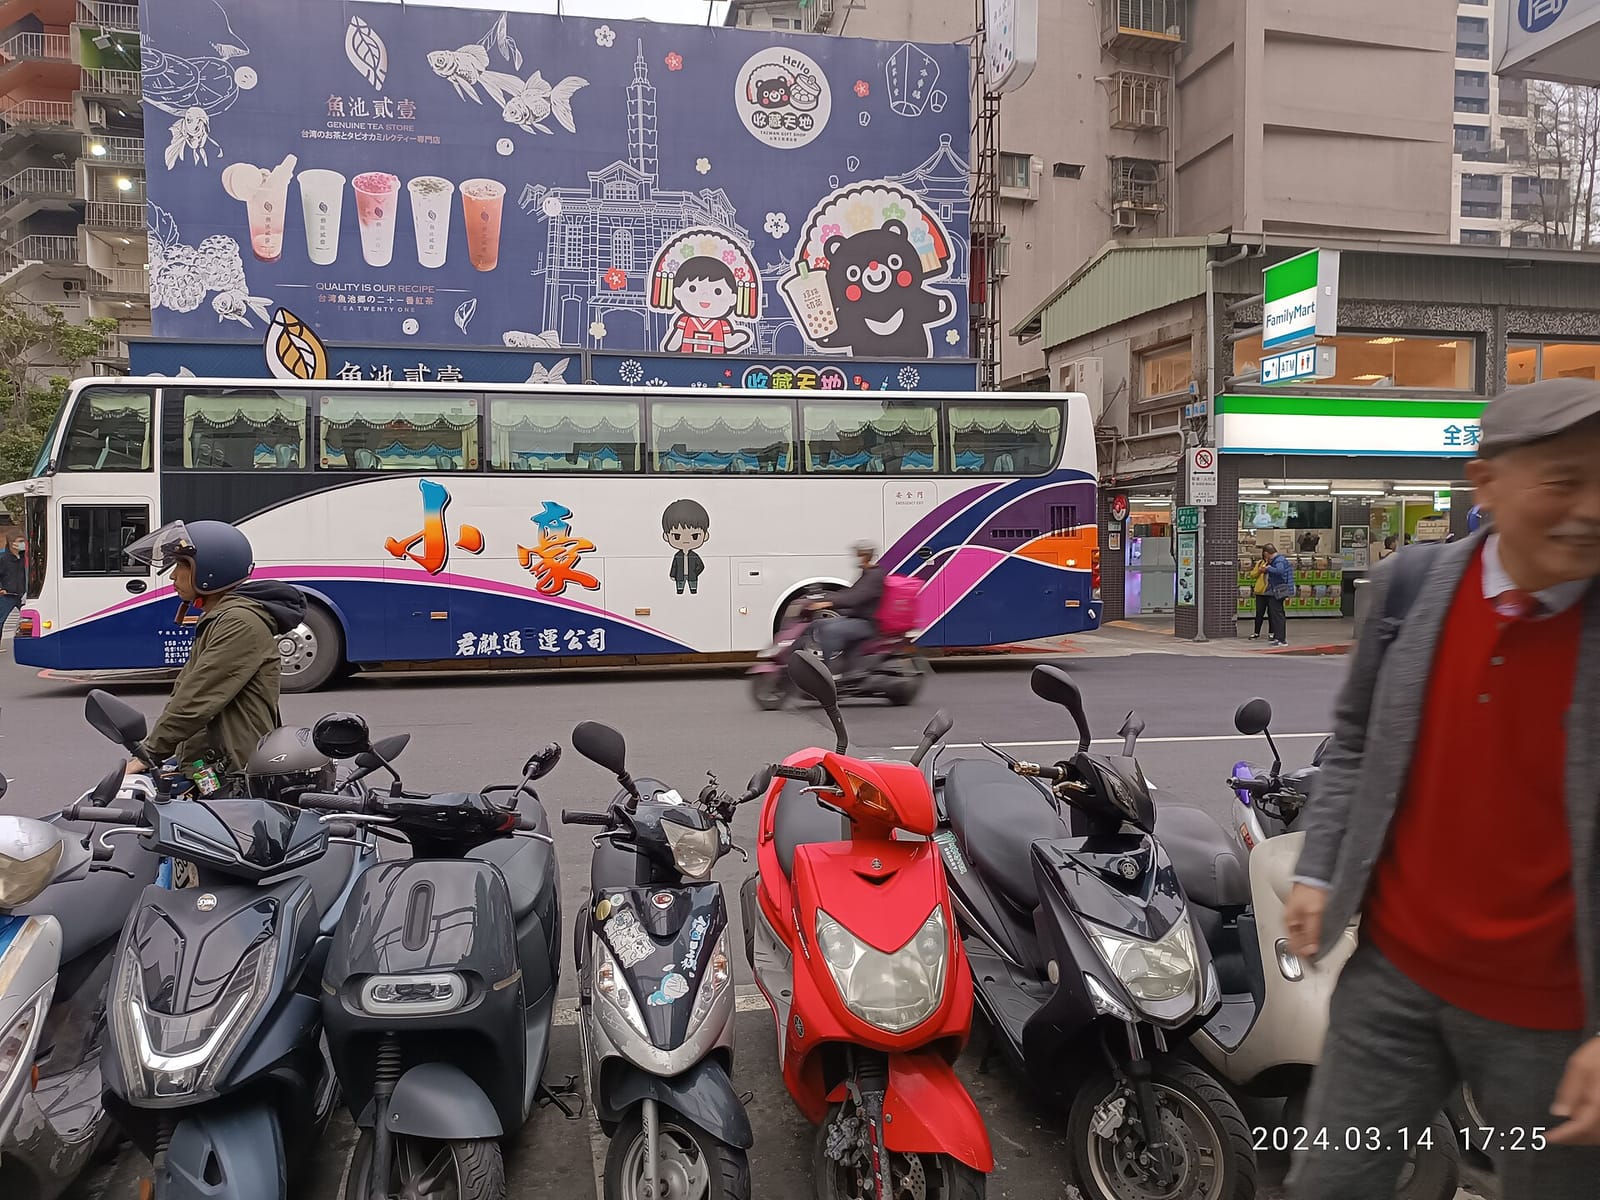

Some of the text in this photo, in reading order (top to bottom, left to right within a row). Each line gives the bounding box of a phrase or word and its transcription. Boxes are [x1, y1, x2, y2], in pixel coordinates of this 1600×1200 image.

[782, 55, 811, 75] Hello
[326, 94, 417, 119] 魚池貳壹
[326, 121, 415, 132] GENUINE TEA STORE
[752, 111, 814, 131] 收藏天地
[316, 282, 435, 294] QUALITY IS OUR RECIPE
[1266, 301, 1315, 328] FamilyMart
[1281, 359, 1295, 374] ATM
[1443, 424, 1481, 446] 全家
[198, 898, 215, 907] SYM
